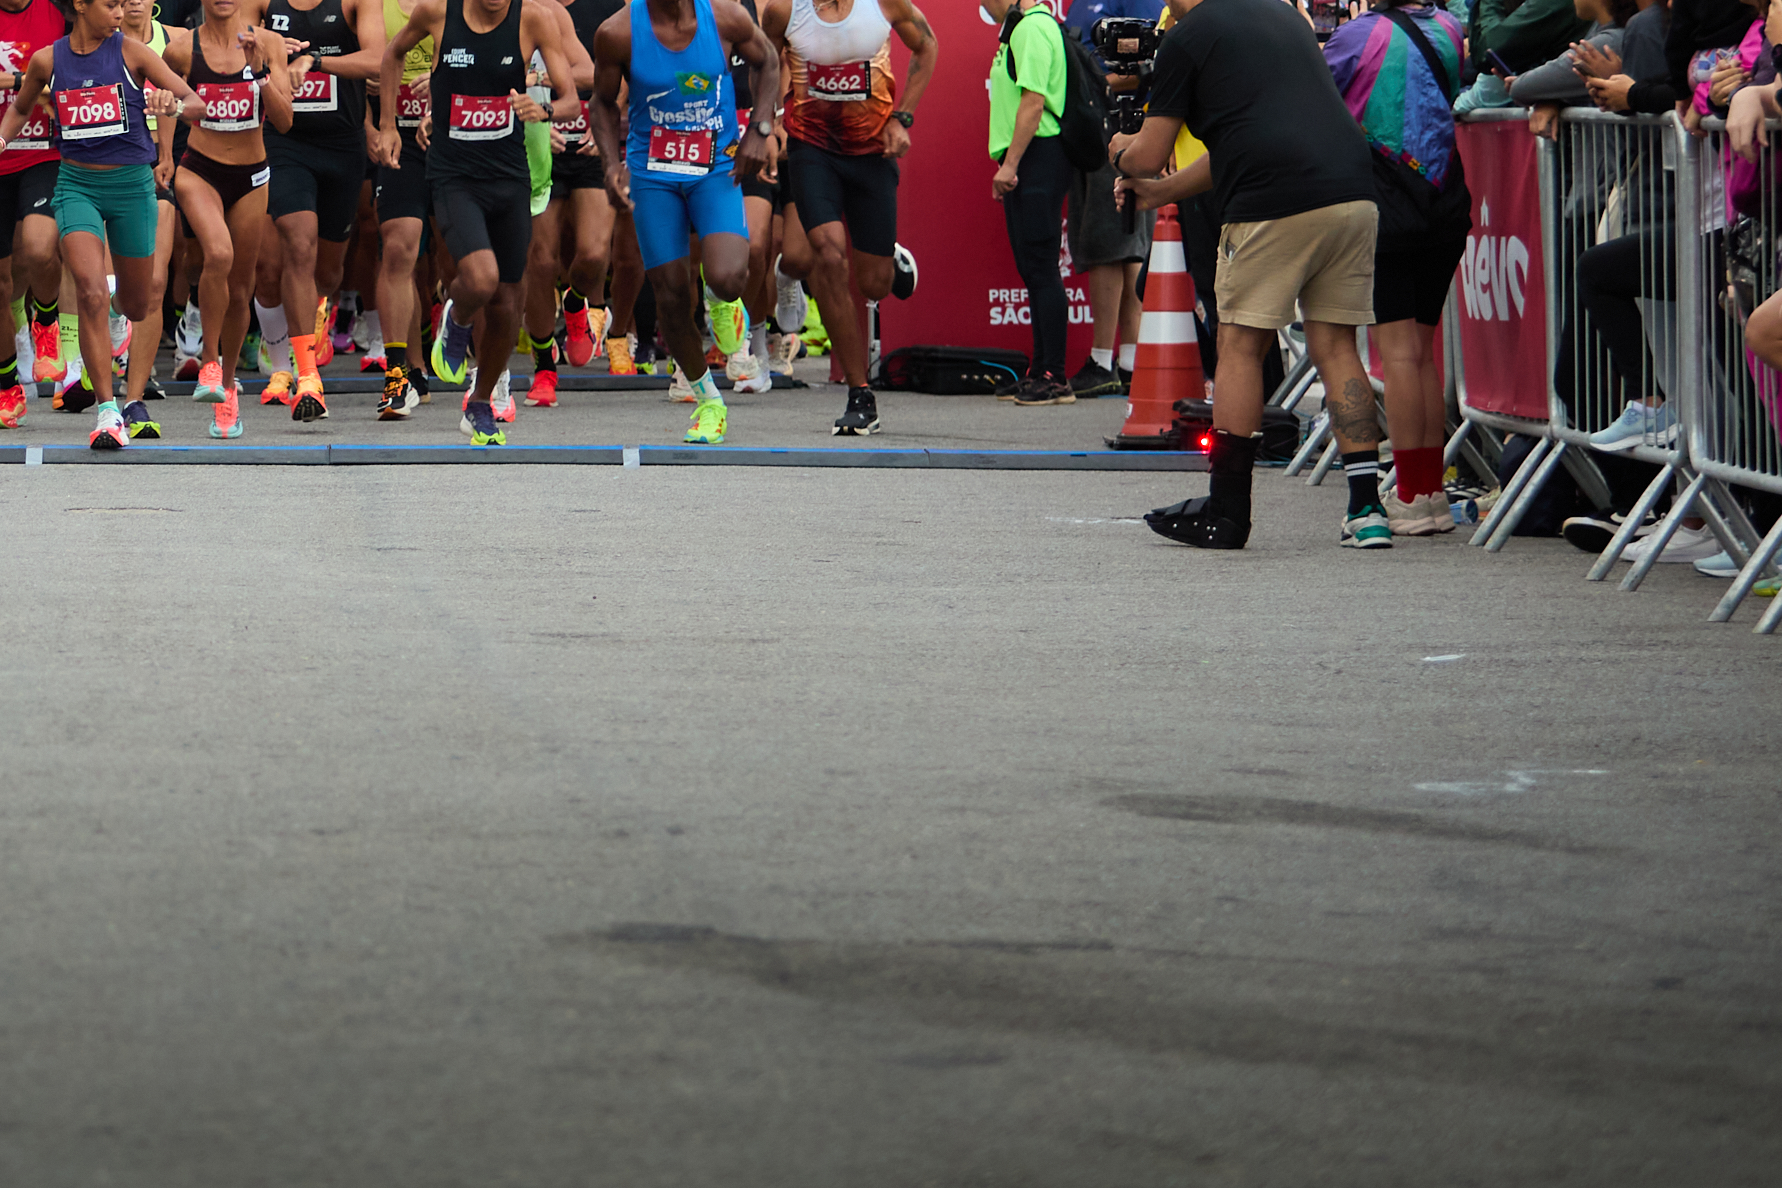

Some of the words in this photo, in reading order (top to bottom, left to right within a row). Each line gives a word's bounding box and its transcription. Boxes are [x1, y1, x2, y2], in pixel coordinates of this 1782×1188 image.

[816, 75, 861, 91] 4662
[68, 102, 116, 124] 7098
[206, 99, 251, 118] 6809
[461, 110, 507, 127] 7093
[664, 142, 700, 161] 515
[989, 288, 1085, 303] PREFRA
[990, 303, 1032, 325] SÃO
